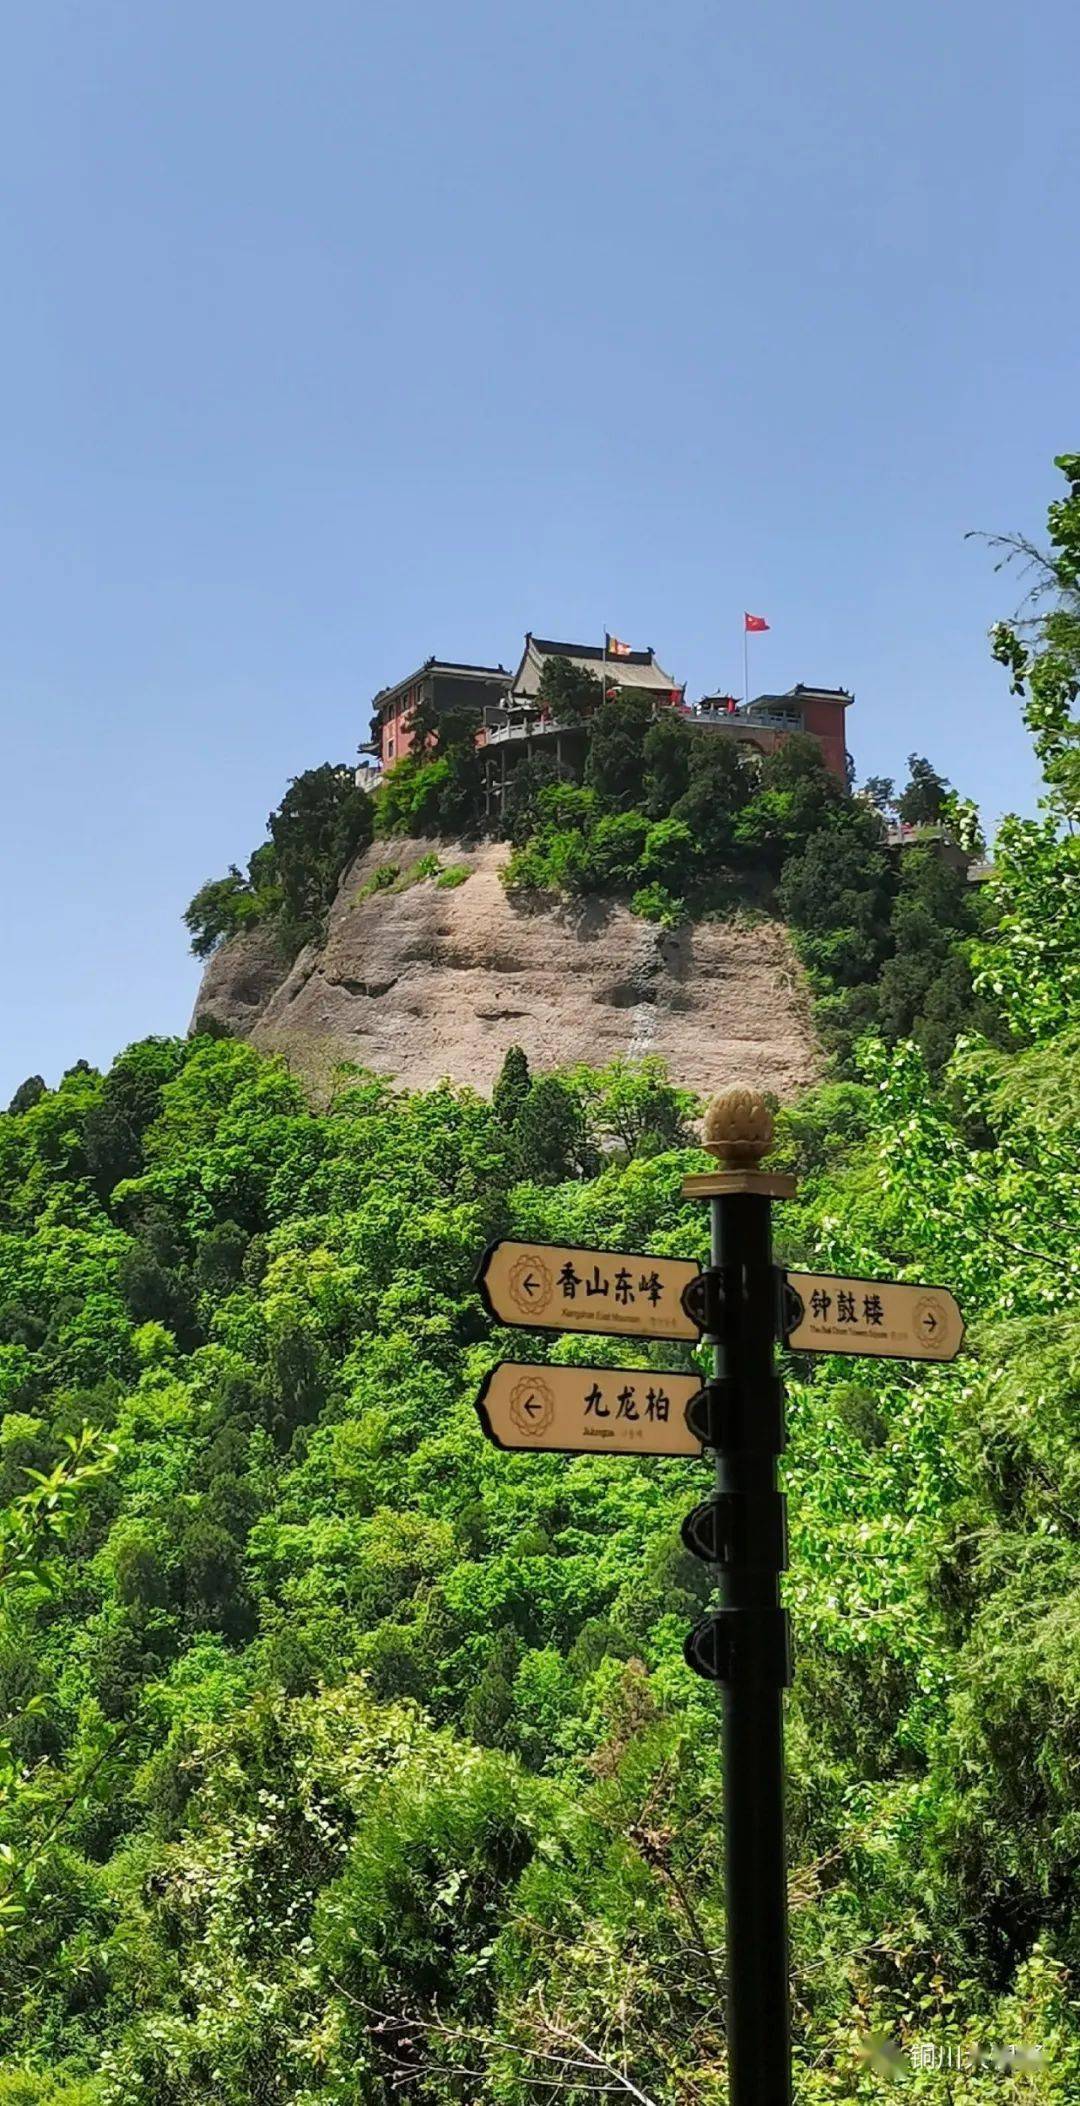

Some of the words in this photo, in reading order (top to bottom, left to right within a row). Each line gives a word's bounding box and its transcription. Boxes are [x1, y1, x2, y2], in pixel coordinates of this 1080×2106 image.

[556, 1261, 665, 1308] 香山东峰
[808, 1288, 884, 1326] 钟鼓楼
[583, 1382, 670, 1423] 九龙柏
